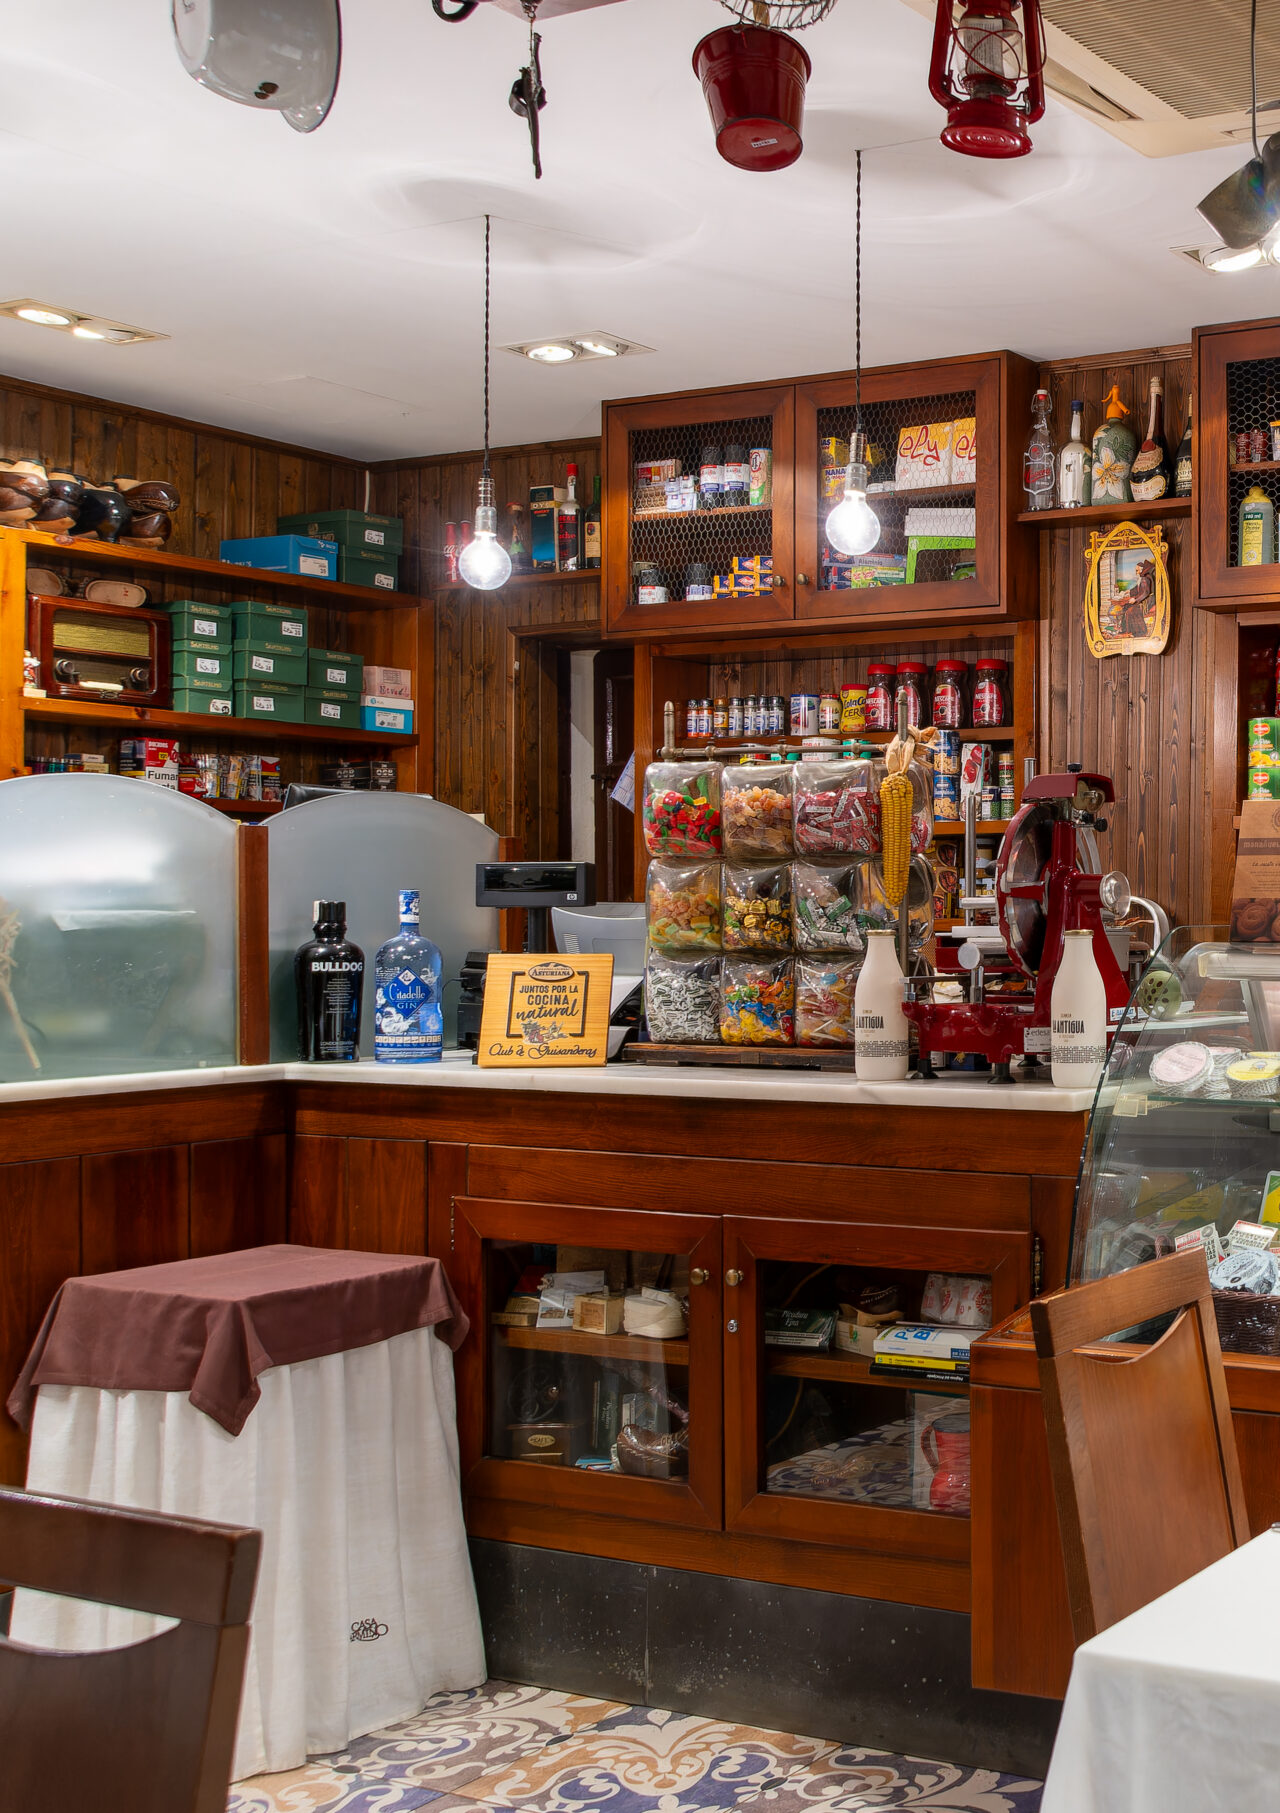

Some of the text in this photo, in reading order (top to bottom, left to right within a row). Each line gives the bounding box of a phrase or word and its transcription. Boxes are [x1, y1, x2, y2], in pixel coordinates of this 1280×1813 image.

[311, 961, 363, 972] BULLDOG
[520, 985, 579, 994] JUNTOS POR LA
[527, 994, 570, 1006] COCINA
[397, 1002, 418, 1010] GIN
[515, 998, 580, 1021] natural
[351, 1617, 377, 1632] CASA
